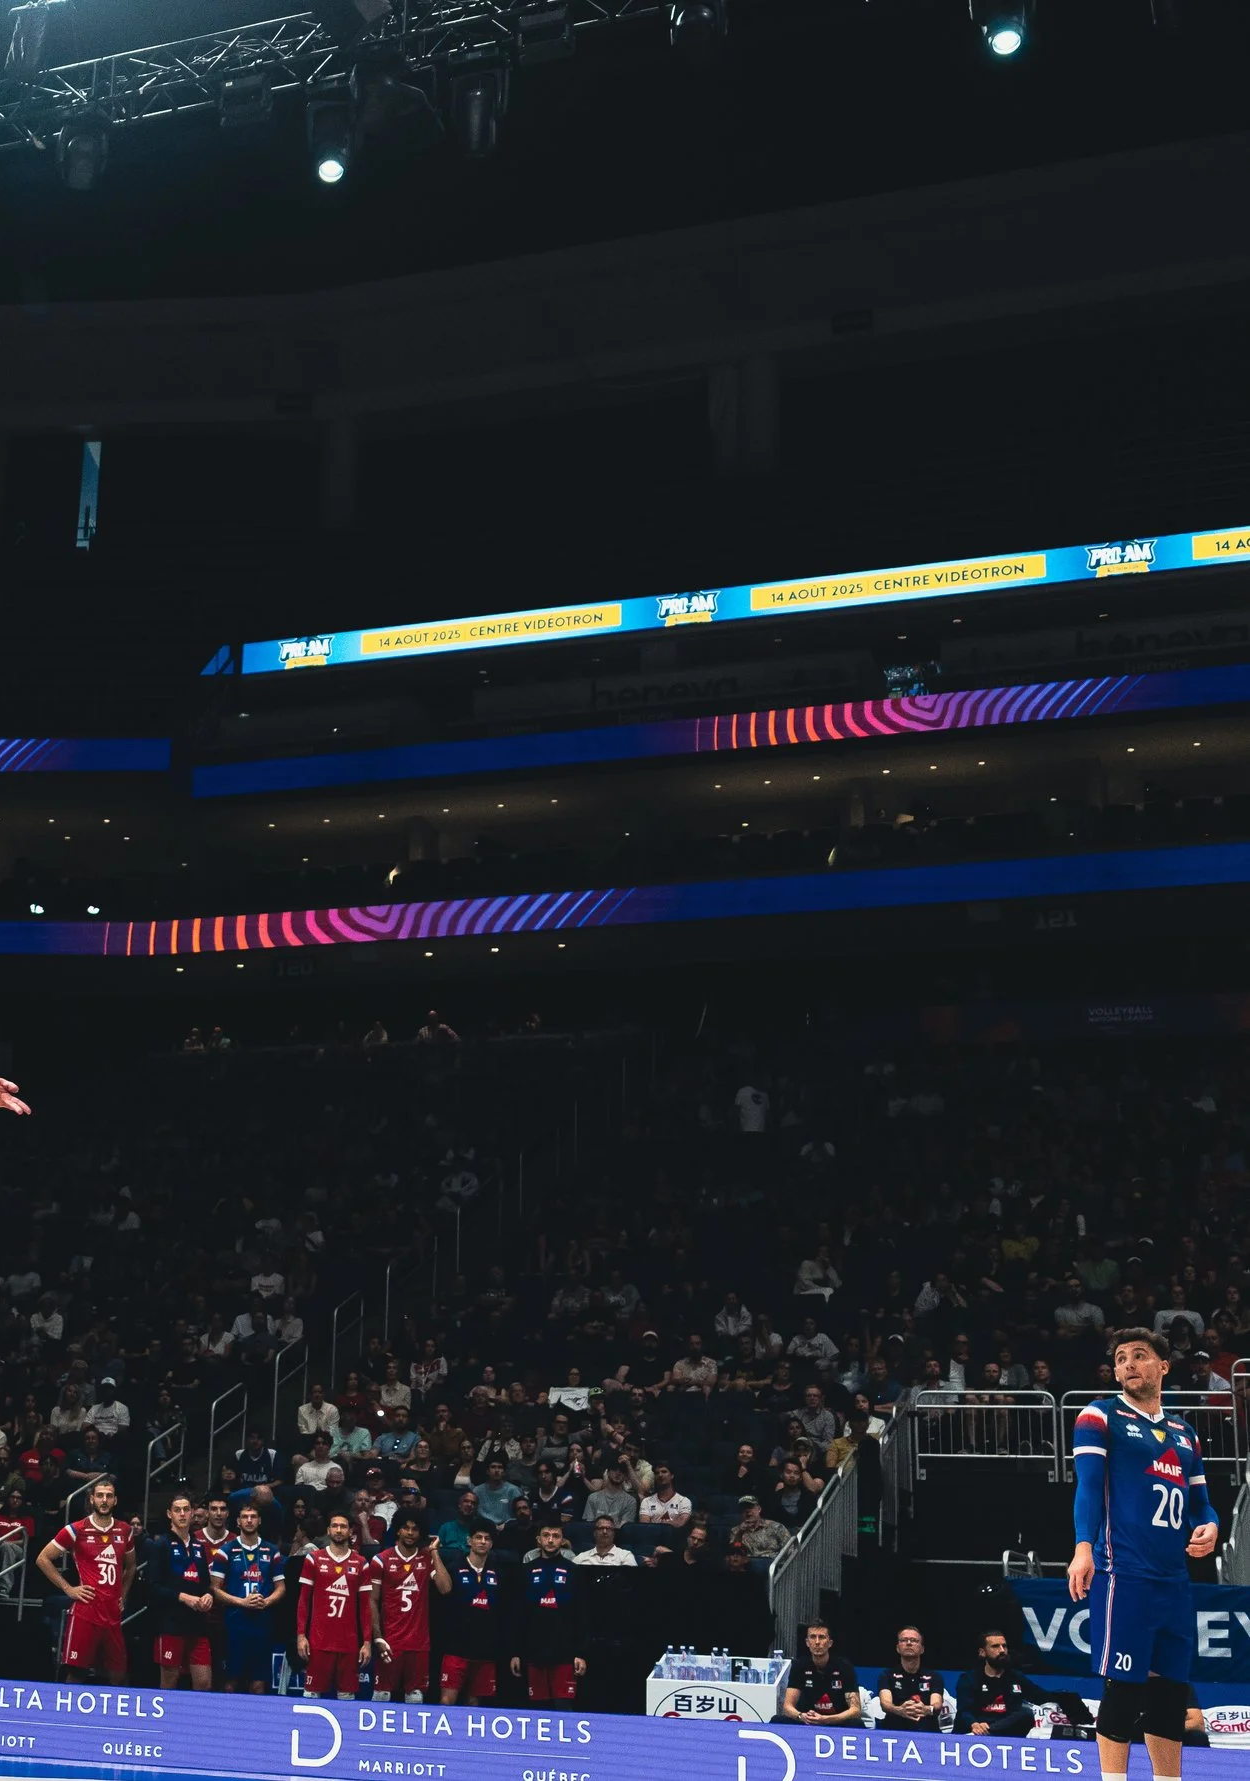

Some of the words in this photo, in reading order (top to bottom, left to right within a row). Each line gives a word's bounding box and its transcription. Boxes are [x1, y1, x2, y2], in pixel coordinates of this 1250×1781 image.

[1090, 543, 1152, 567] PRO-AM
[1215, 540, 1230, 551] 14
[771, 592, 784, 602] 14
[788, 584, 827, 601] AOÛT
[832, 583, 863, 596] 2025
[873, 574, 930, 591] CENTRE
[934, 563, 1025, 583] VIDÉOTRON
[379, 638, 390, 647] 14
[394, 630, 429, 645] AOÛT
[432, 630, 461, 641] 2025
[469, 622, 519, 637] CENTRE
[524, 612, 604, 630] VIDÉOTRON
[1034, 910, 1077, 930] 121
[1153, 1460, 1182, 1477] MAIF
[1152, 1484, 1184, 1530] 20
[98, 1564, 116, 1586] 30
[327, 1596, 346, 1618] 37
[401, 1591, 412, 1612] 5
[1114, 1652, 1132, 1671] 20
[56, 1690, 165, 1718] HOTELS
[674, 1694, 737, 1714] 百岁山
[359, 1708, 453, 1736] DELTA
[467, 1714, 592, 1744] HOTELS
[103, 1741, 162, 1758] QUÉBEC
[816, 1734, 923, 1764] DELTA
[940, 1741, 1083, 1774] HOTELS
[359, 1759, 447, 1777] MARRIOTT
[523, 1768, 591, 1781] QUÉBEC
